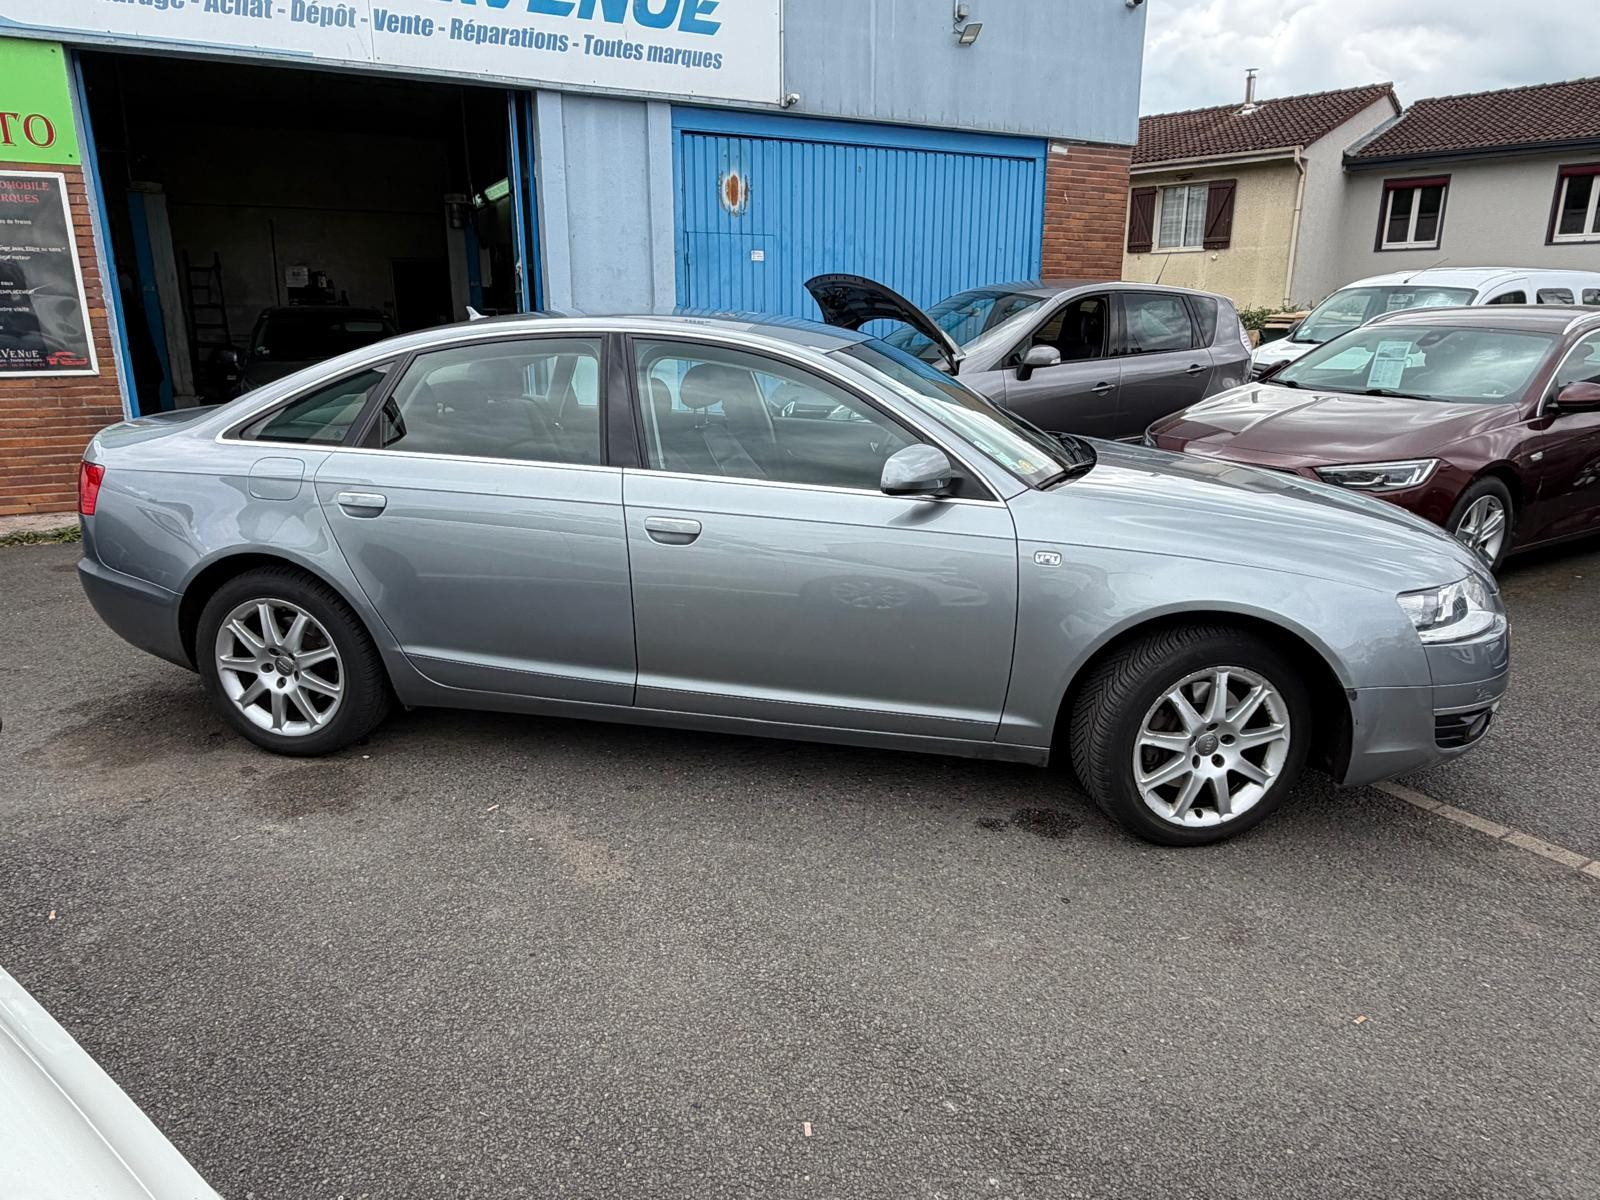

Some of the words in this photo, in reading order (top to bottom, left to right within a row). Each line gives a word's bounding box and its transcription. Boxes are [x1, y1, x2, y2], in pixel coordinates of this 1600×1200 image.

[204, 0, 272, 19] Achat
[290, 5, 356, 28] Dépôt
[373, 8, 434, 37] Vente
[450, 18, 568, 52] Réparations
[583, 34, 643, 61] Toutes
[646, 45, 723, 70] marques
[0, 193, 39, 204] RQUES
